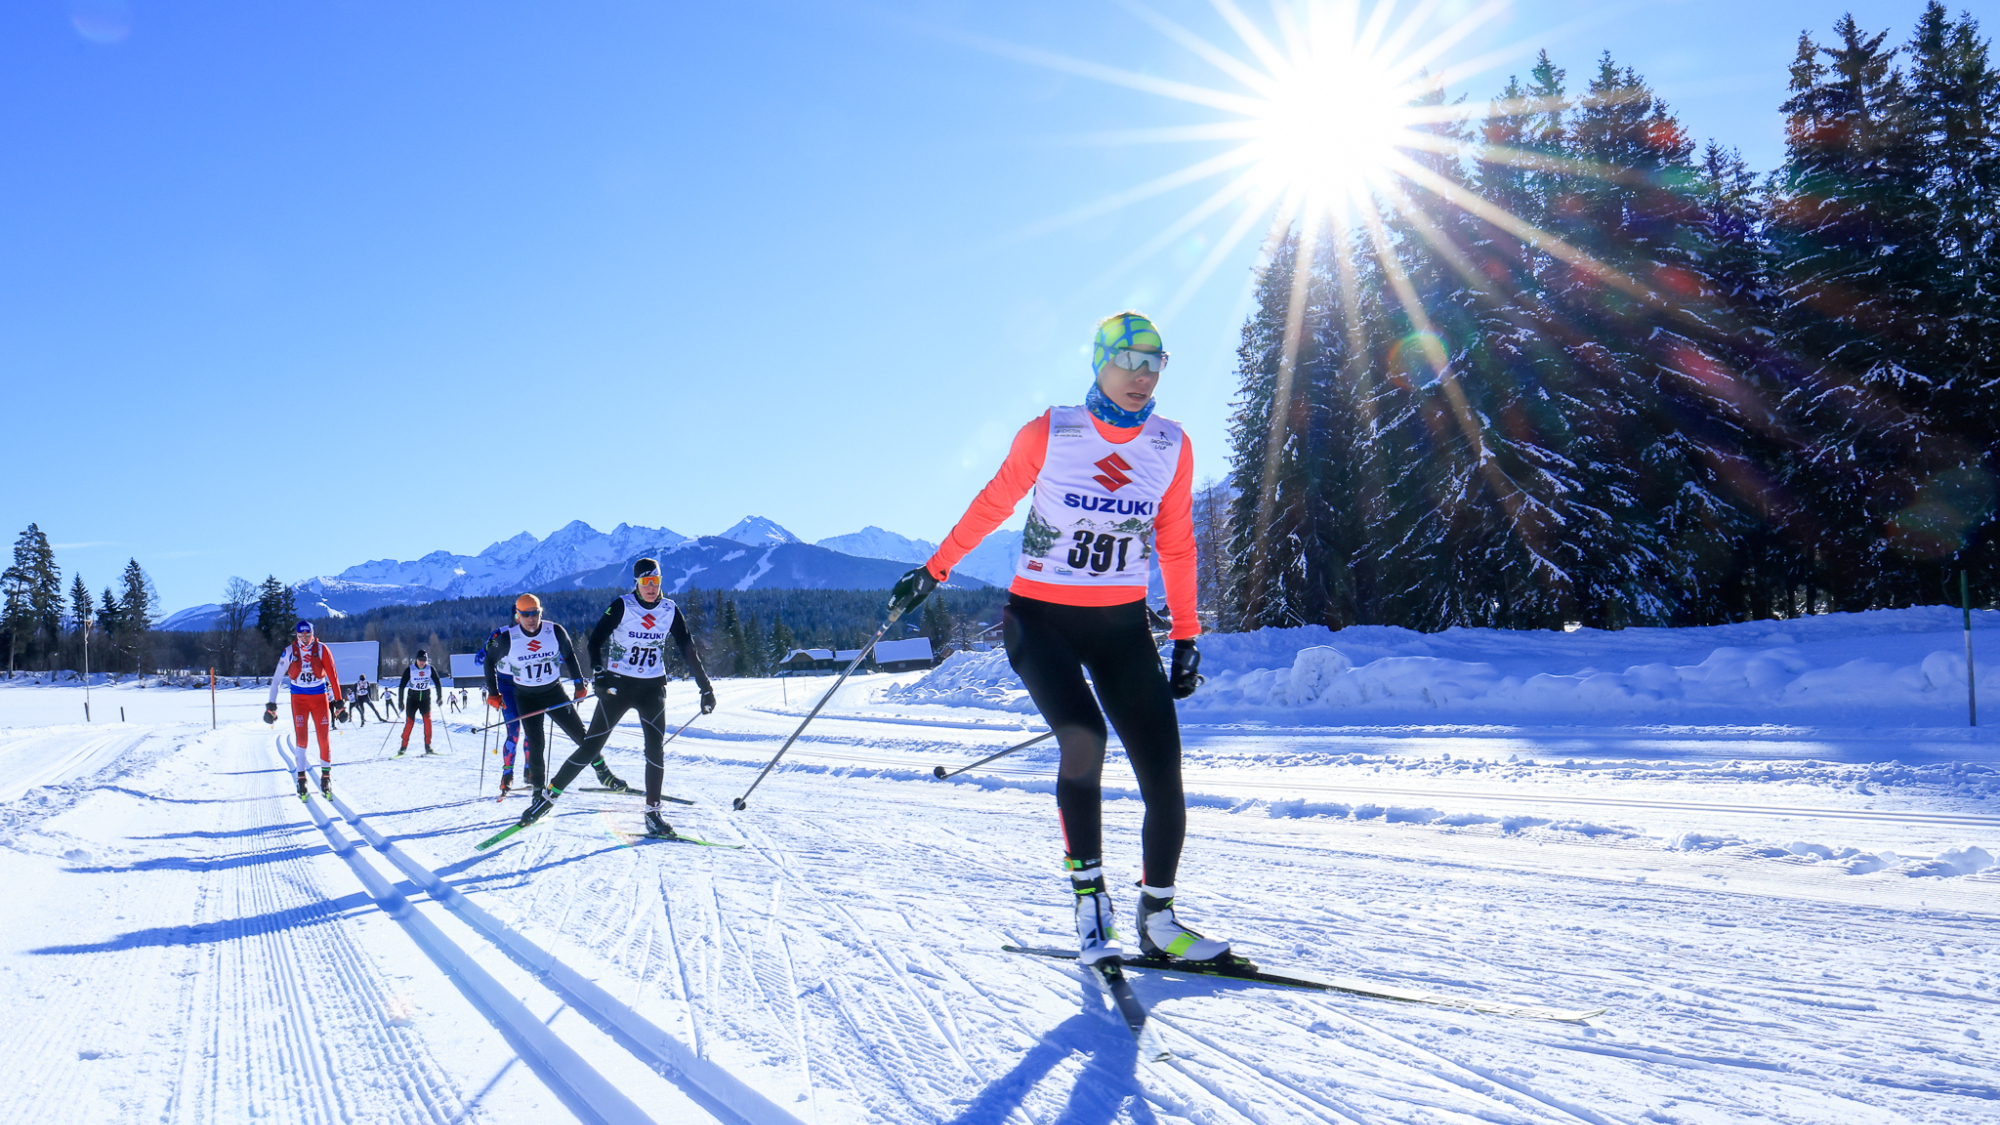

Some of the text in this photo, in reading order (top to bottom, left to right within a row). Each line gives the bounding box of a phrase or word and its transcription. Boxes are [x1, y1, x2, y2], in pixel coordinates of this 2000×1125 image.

[1063, 493, 1153, 515] SUZUKI
[1067, 530, 1133, 572] 391
[628, 631, 664, 640] SUZUKI
[517, 651, 554, 661] SUZUKI
[629, 646, 657, 667] 375
[525, 662, 552, 678] 174
